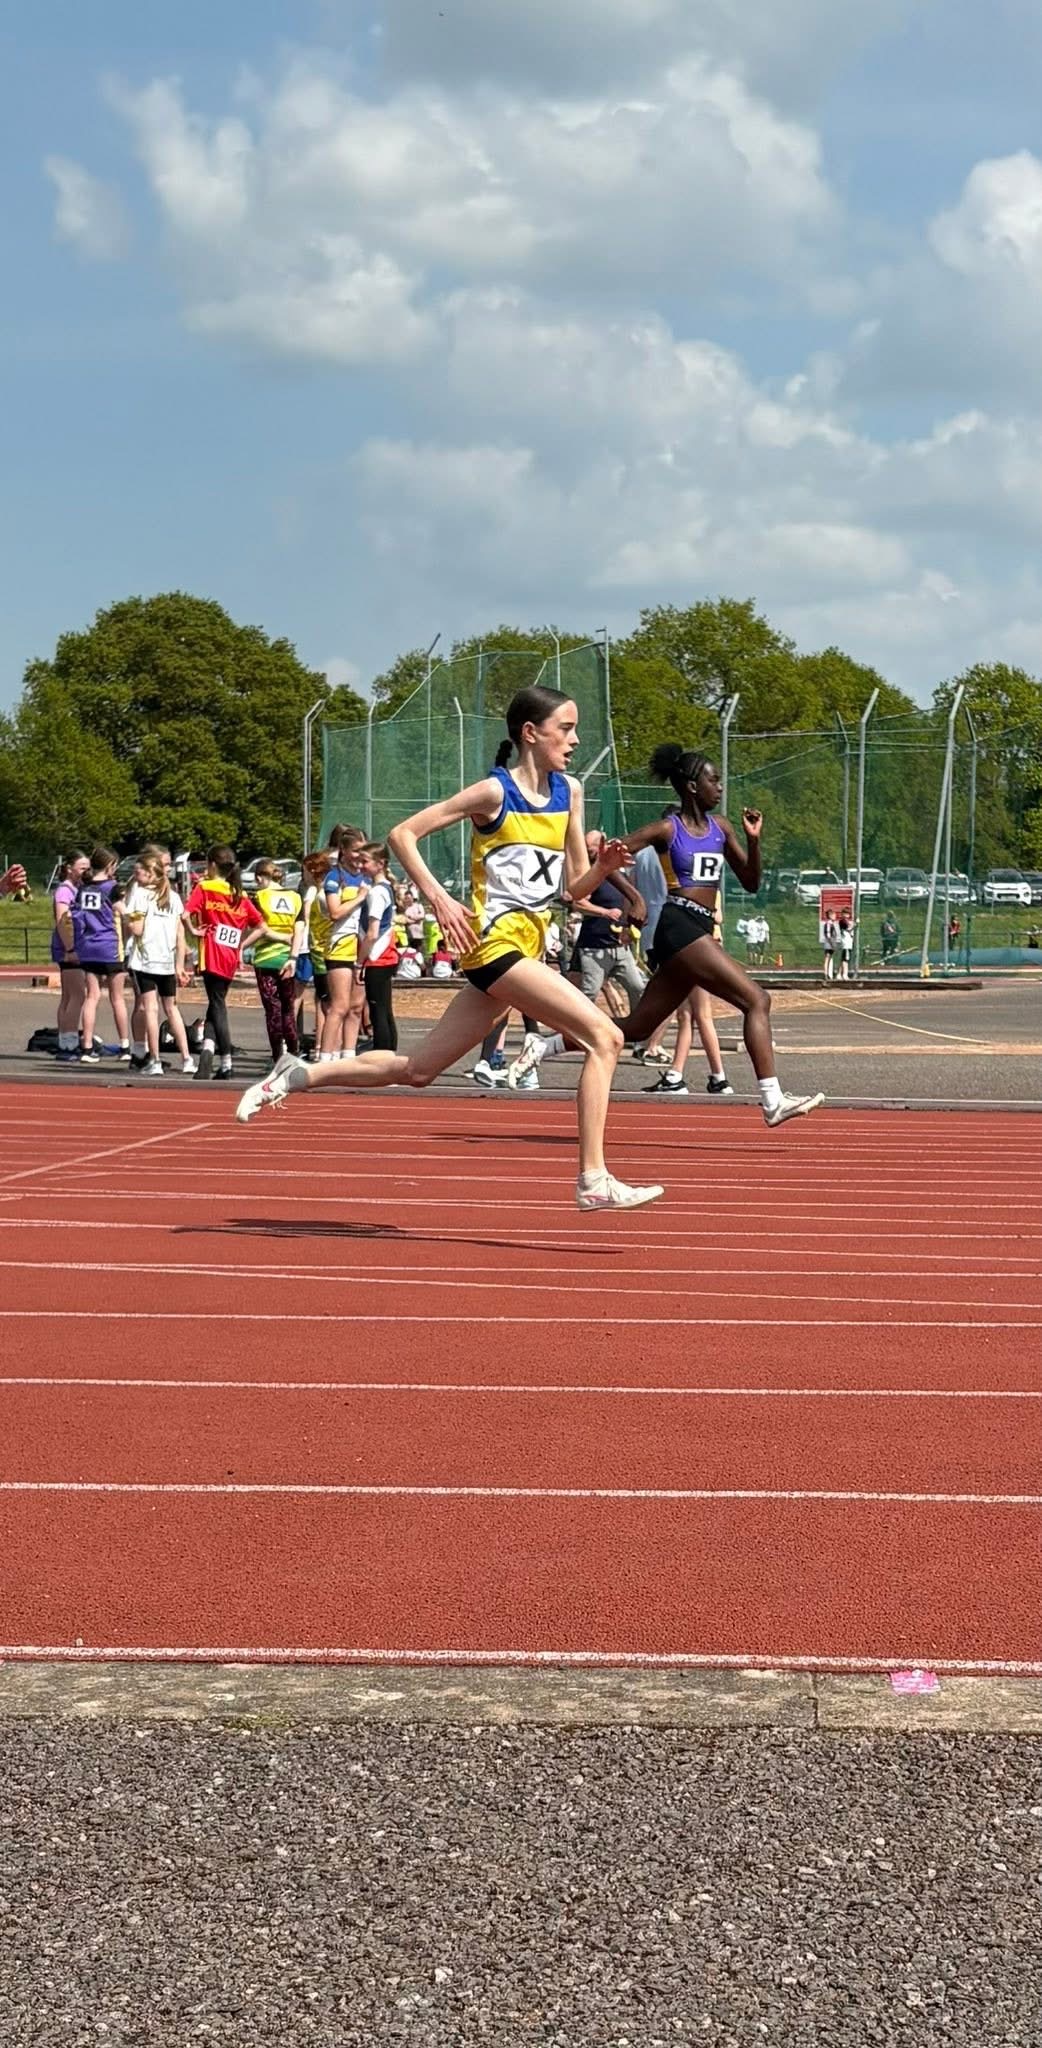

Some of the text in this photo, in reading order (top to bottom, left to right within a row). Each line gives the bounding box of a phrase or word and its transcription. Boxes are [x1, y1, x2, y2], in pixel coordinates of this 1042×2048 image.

[528, 850, 559, 887] X
[700, 856, 718, 877] R
[85, 895, 97, 907] R
[276, 898, 290, 910] A
[219, 927, 238, 944] BB
